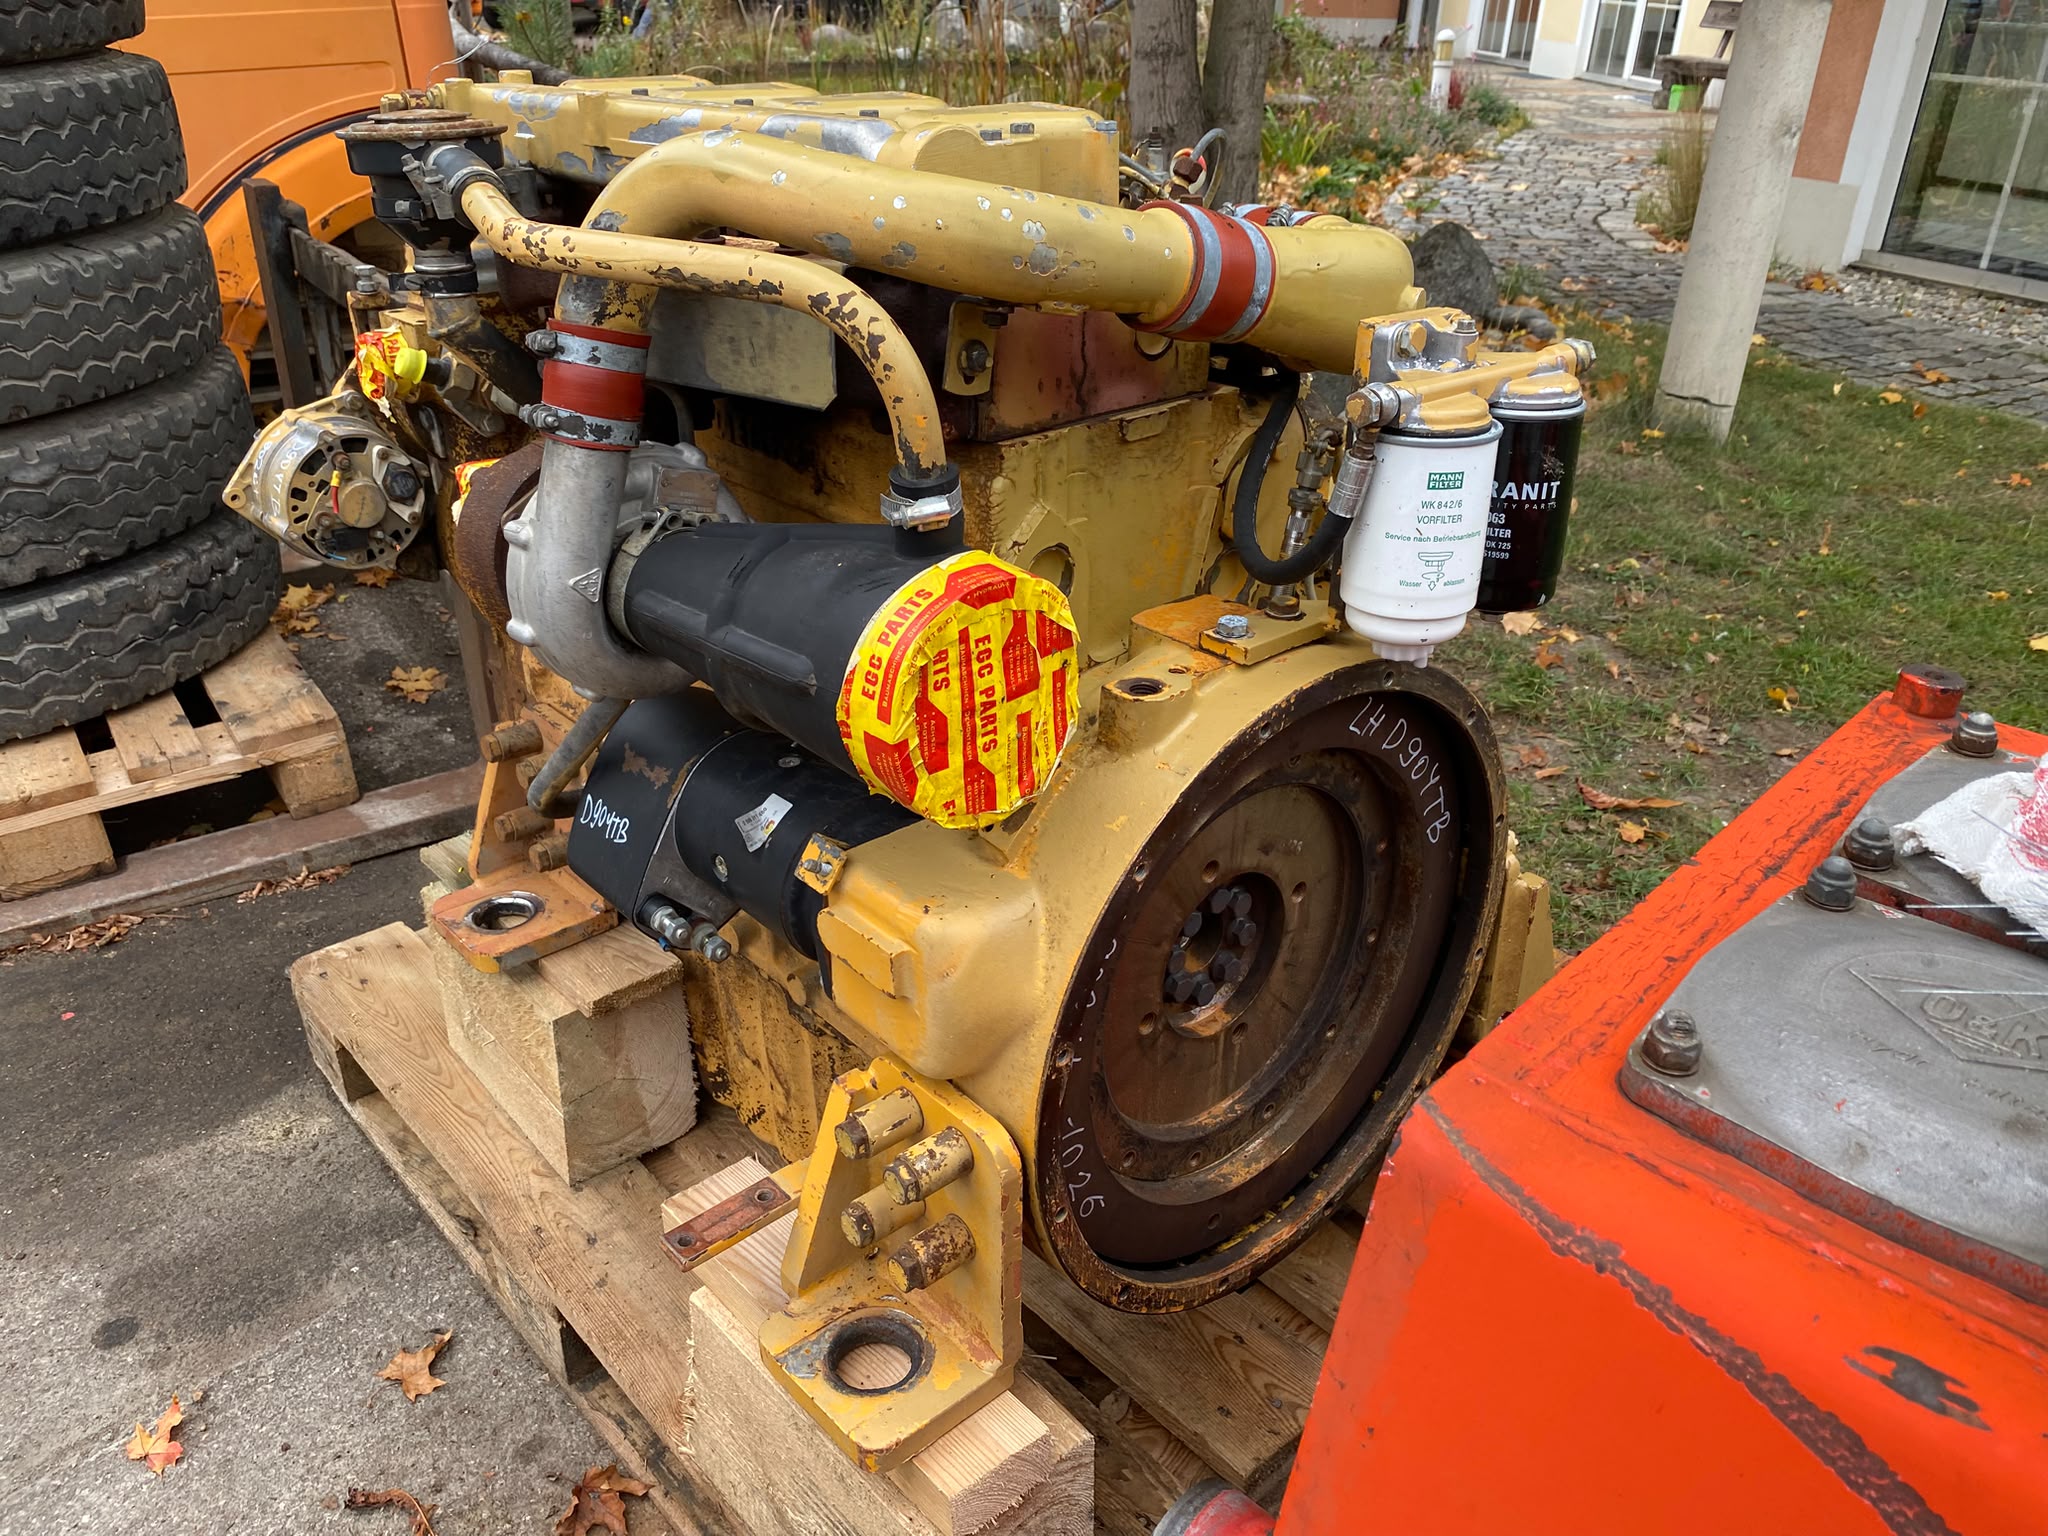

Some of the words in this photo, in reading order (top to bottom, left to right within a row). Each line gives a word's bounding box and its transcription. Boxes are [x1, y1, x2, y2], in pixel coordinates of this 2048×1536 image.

[1430, 473, 1463, 481] MANN
[1429, 480, 1462, 489] FILTER
[1421, 500, 1436, 510] WK
[1437, 500, 1463, 509] 842/6
[1525, 501, 1557, 510] PARTS
[1417, 514, 1463, 525] VORFILTER
[1385, 531, 1412, 541] Service
[1413, 535, 1432, 543] nach
[1498, 542, 1511, 550] 725
[1399, 579, 1422, 588] Wasser
[861, 653, 883, 701] EGC
[877, 588, 934, 648] PARTS
[882, 644, 906, 708] BAUMASCHINEN
[907, 597, 949, 638] DEMONTAGEN
[974, 633, 994, 679] EGC
[960, 643, 969, 704] BAUMASCHINEN
[978, 684, 998, 753] PARTS
[580, 793, 630, 844] D904TB
